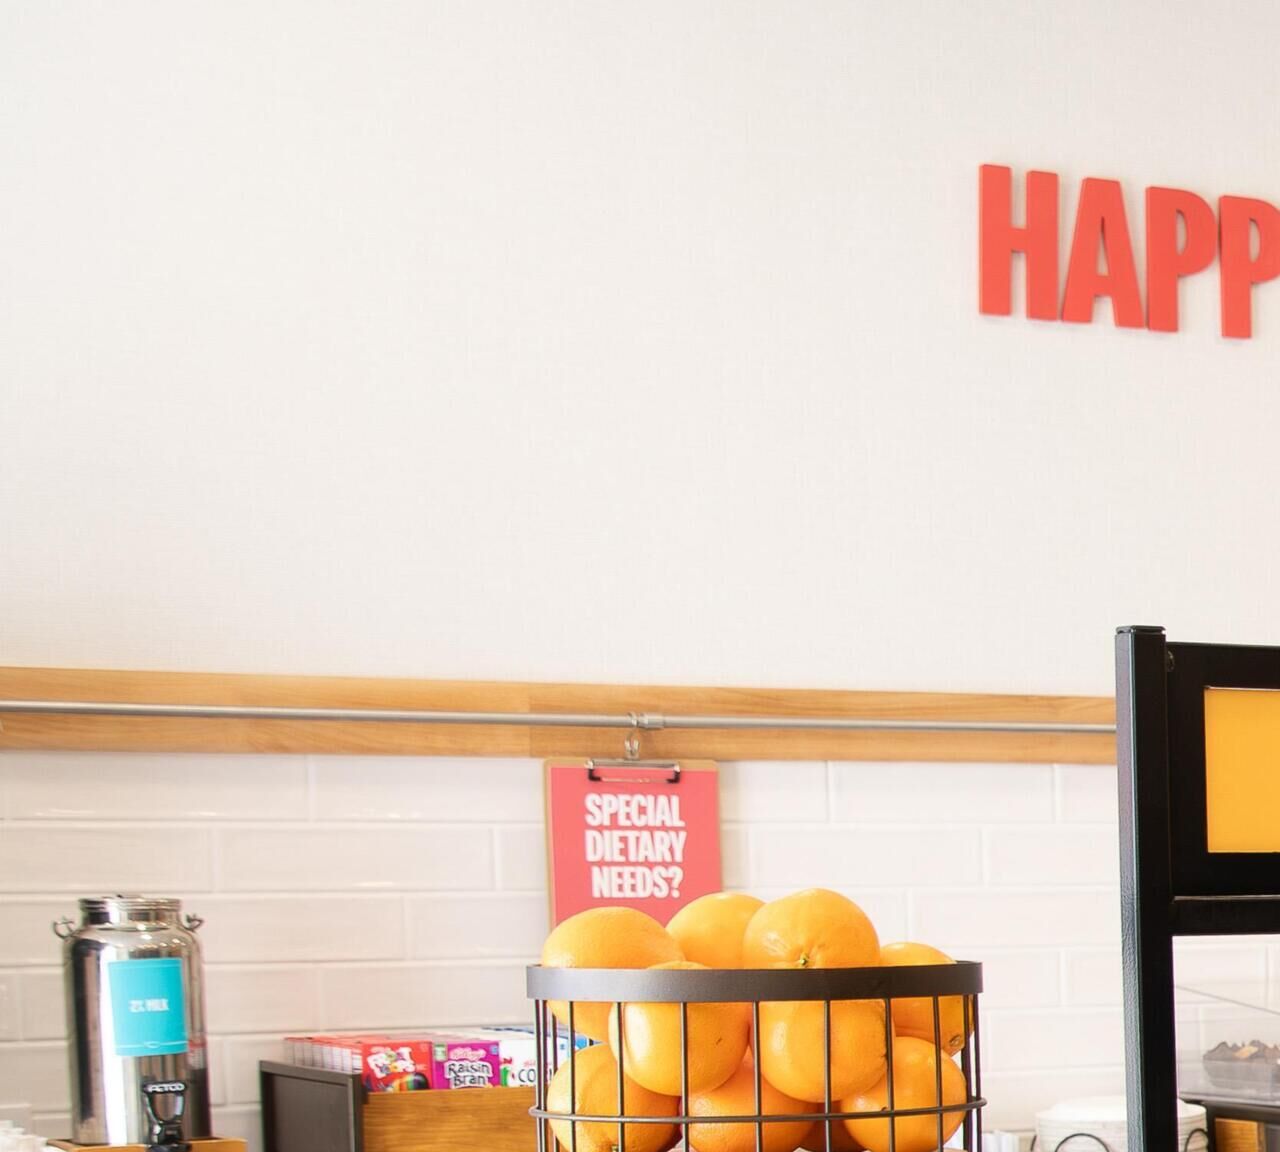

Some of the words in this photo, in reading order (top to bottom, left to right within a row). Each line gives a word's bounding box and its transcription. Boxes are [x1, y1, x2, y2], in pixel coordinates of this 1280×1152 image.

[584, 793, 686, 827] SPECIAL
[585, 829, 687, 863] DIETARY
[591, 865, 684, 898] NEEDS?
[448, 1062, 490, 1077] Raisin
[454, 1075, 486, 1087] Bran
